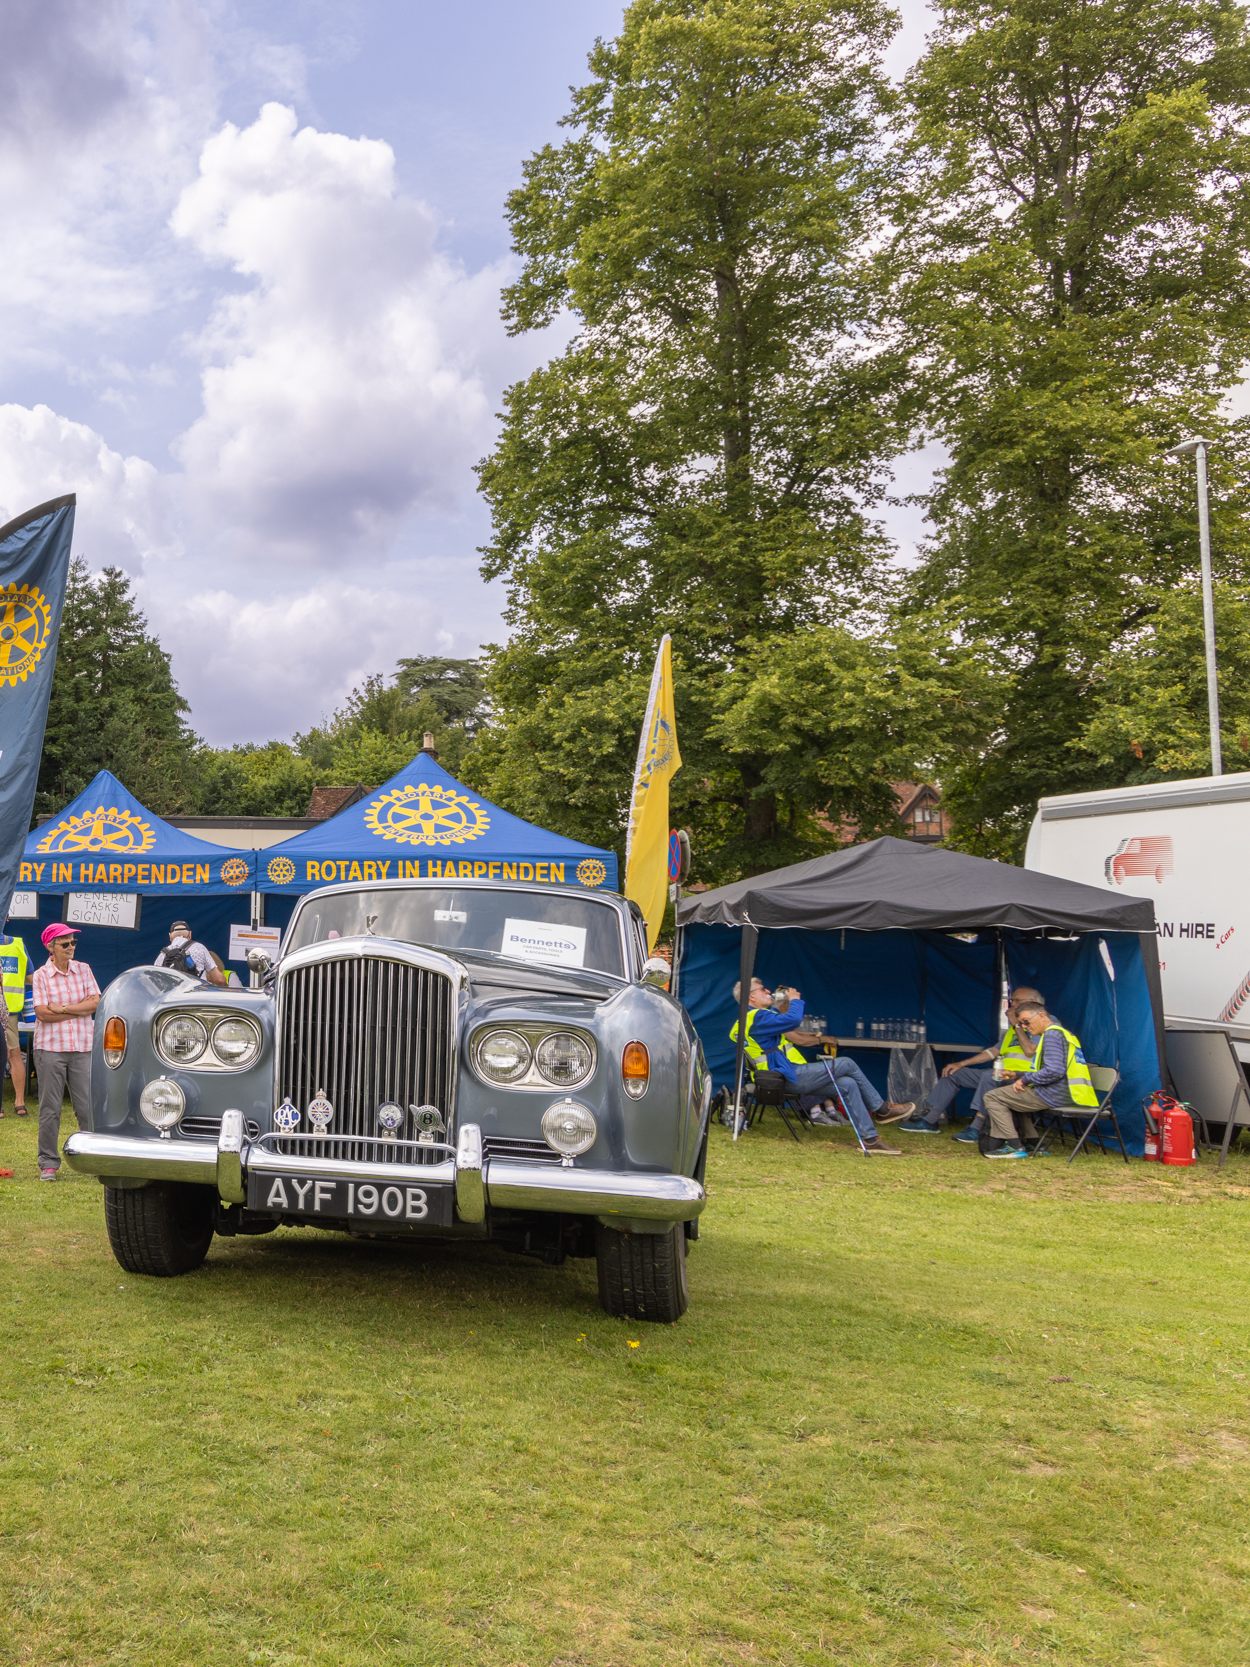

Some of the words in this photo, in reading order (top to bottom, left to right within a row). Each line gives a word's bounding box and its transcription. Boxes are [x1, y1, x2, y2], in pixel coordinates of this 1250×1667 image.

[400, 791, 449, 801] ROTARY
[76, 812, 123, 827] ROTARY
[386, 826, 474, 841] INTERNATIONAL
[52, 862, 73, 883] IN
[80, 863, 210, 884] HARPENDEN
[306, 860, 392, 881] ROTARY
[398, 860, 420, 880] IN
[427, 860, 565, 883] HARPENDEN
[84, 900, 119, 913] TASKS
[72, 910, 120, 925] SIGN-IN
[1179, 922, 1215, 939] HIRE
[1220, 926, 1235, 944] Cars
[510, 934, 571, 950] Bennetts
[278, 1106, 300, 1124] RAC
[422, 1112, 433, 1125] B
[266, 1177, 337, 1212] AYF
[347, 1183, 429, 1220] 190B
